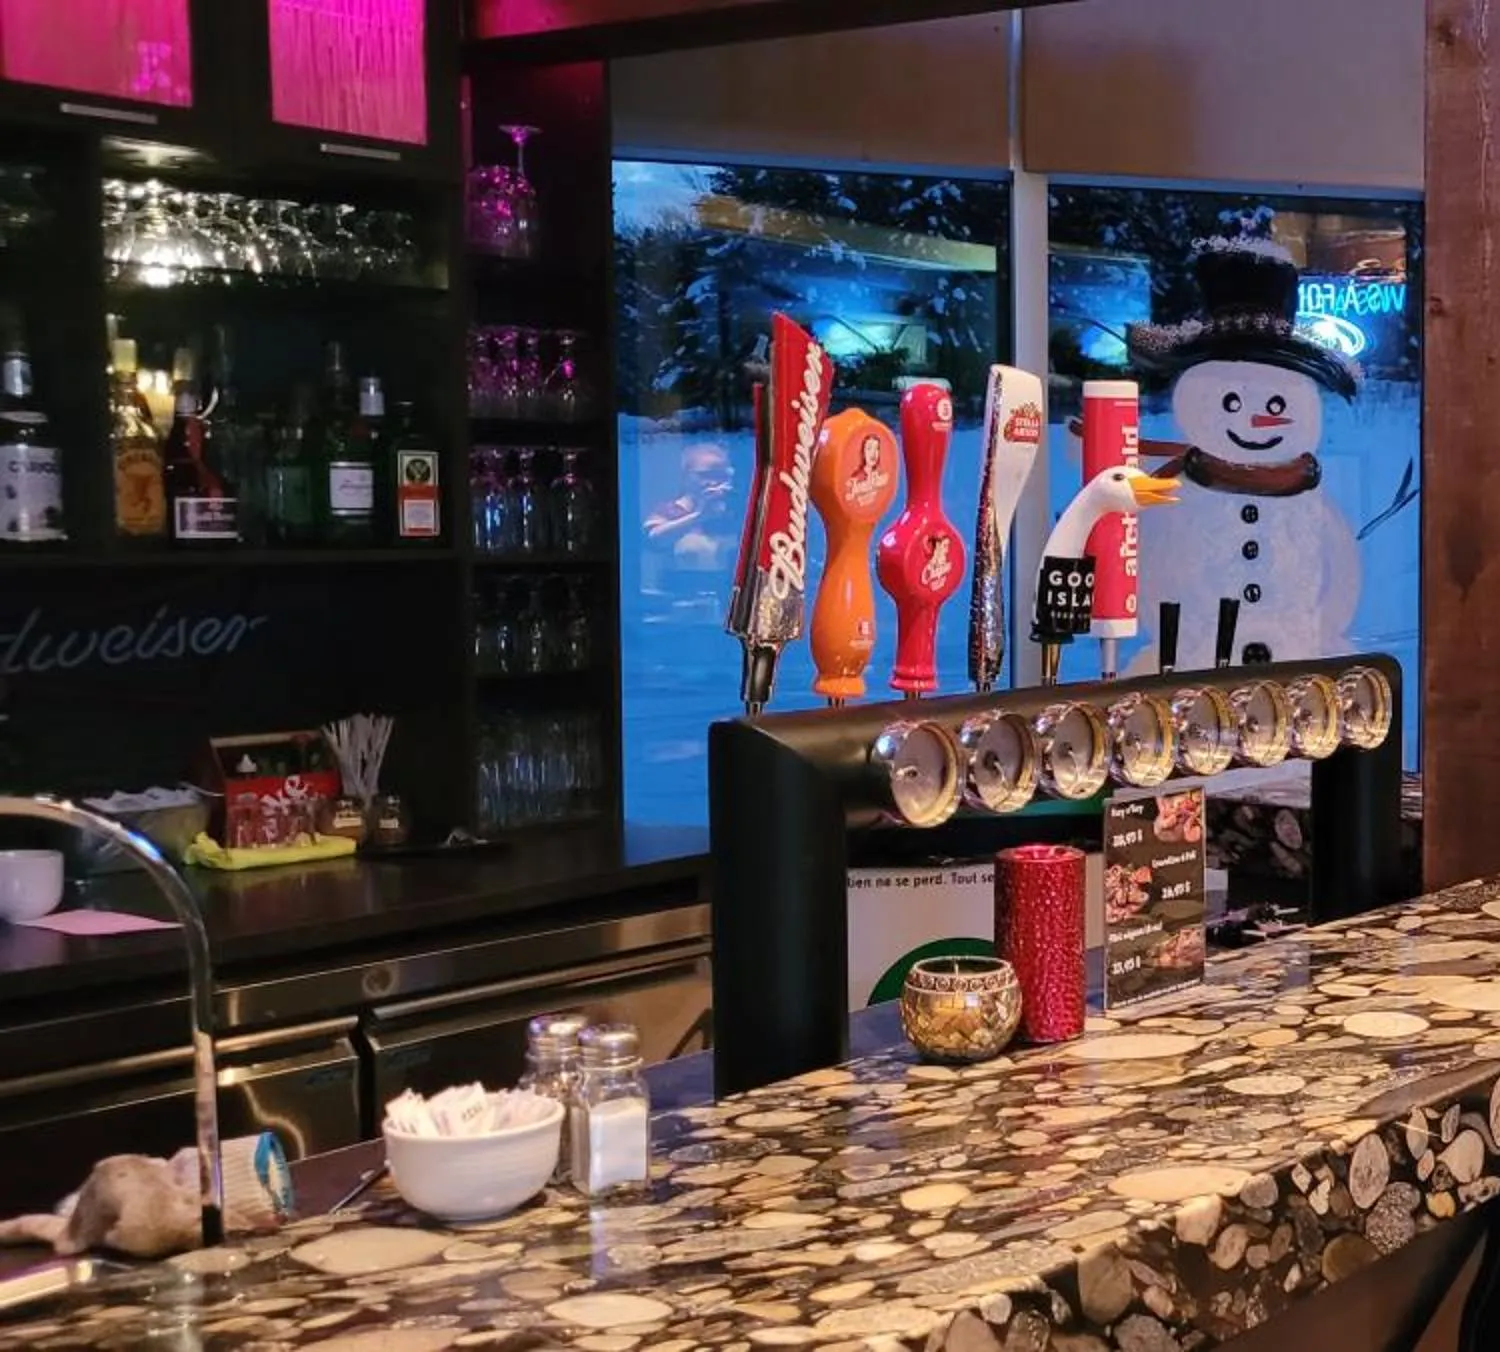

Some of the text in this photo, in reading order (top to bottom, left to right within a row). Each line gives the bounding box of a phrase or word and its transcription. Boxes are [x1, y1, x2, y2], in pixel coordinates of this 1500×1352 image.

[769, 341, 822, 599] Budweiser
[1048, 570, 1095, 588] GOO
[1047, 590, 1095, 607] ISLA
[848, 876, 871, 888] ien
[895, 876, 909, 887] se
[913, 873, 946, 888] perd.
[951, 871, 977, 885] Tout
